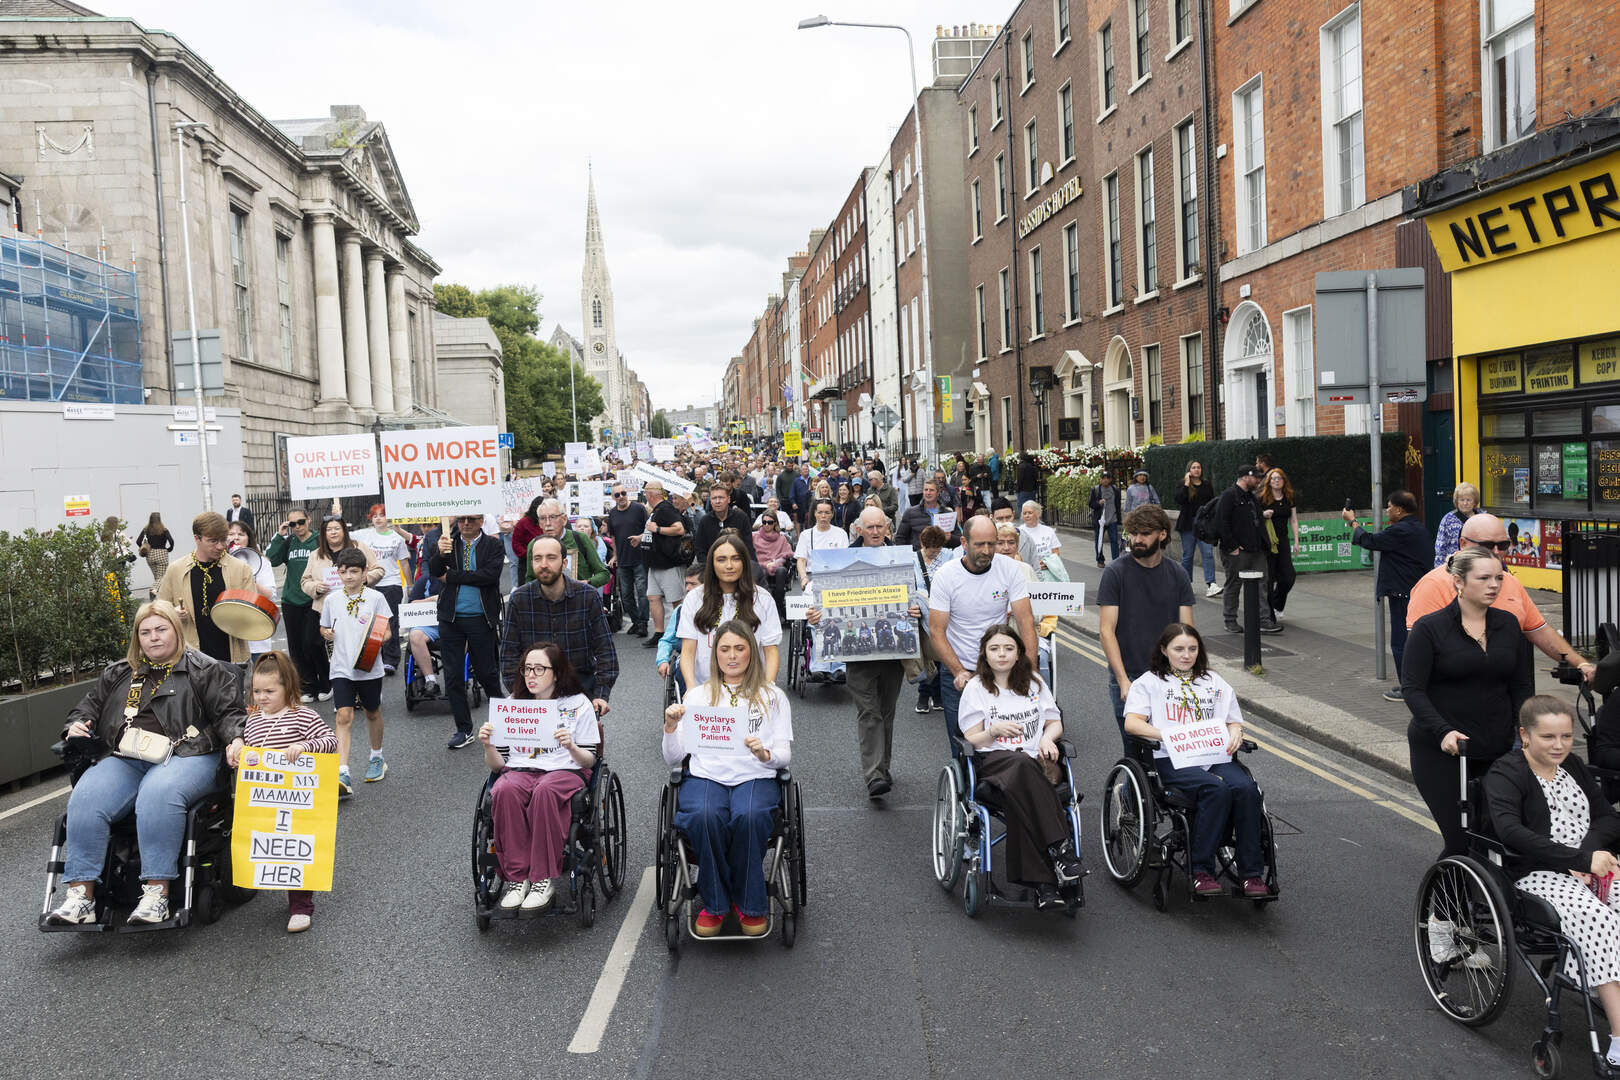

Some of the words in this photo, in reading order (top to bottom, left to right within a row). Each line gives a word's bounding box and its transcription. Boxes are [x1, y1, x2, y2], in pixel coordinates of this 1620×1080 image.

[1052, 175, 1083, 215] HOTEL
[1449, 173, 1620, 263] NETPR
[1591, 346, 1617, 361] XEROX
[1596, 361, 1617, 375] COPY
[1489, 376, 1518, 390] BURNING
[1530, 375, 1569, 389] PRINTING
[294, 449, 326, 463] OUR
[330, 448, 371, 462] LIVES
[383, 443, 419, 463] NO
[426, 439, 497, 461] MORE
[302, 464, 365, 479] MATTER!
[386, 467, 496, 490] WAITING!
[405, 498, 482, 509] #reimburseskyclarys
[1311, 532, 1350, 543] Hop-off
[1309, 544, 1333, 552] HERE
[832, 589, 846, 597] have
[497, 704, 509, 713] FA
[511, 705, 548, 714] Patients
[504, 715, 540, 725] deserve
[694, 713, 736, 725] Skyclarys
[507, 726, 516, 734] to
[518, 726, 537, 735] live!
[698, 724, 709, 732] for
[711, 724, 721, 733] All
[722, 725, 732, 733] FA
[1169, 732, 1187, 743] NO
[1188, 726, 1222, 739] MORE
[701, 733, 731, 742] Patients
[1174, 737, 1225, 753] WAITING!
[244, 770, 284, 783] HELP
[295, 775, 318, 787] MY
[252, 788, 311, 803] MAMMY
[277, 810, 291, 827] I
[252, 838, 313, 858] NEED
[260, 865, 302, 884] HER
